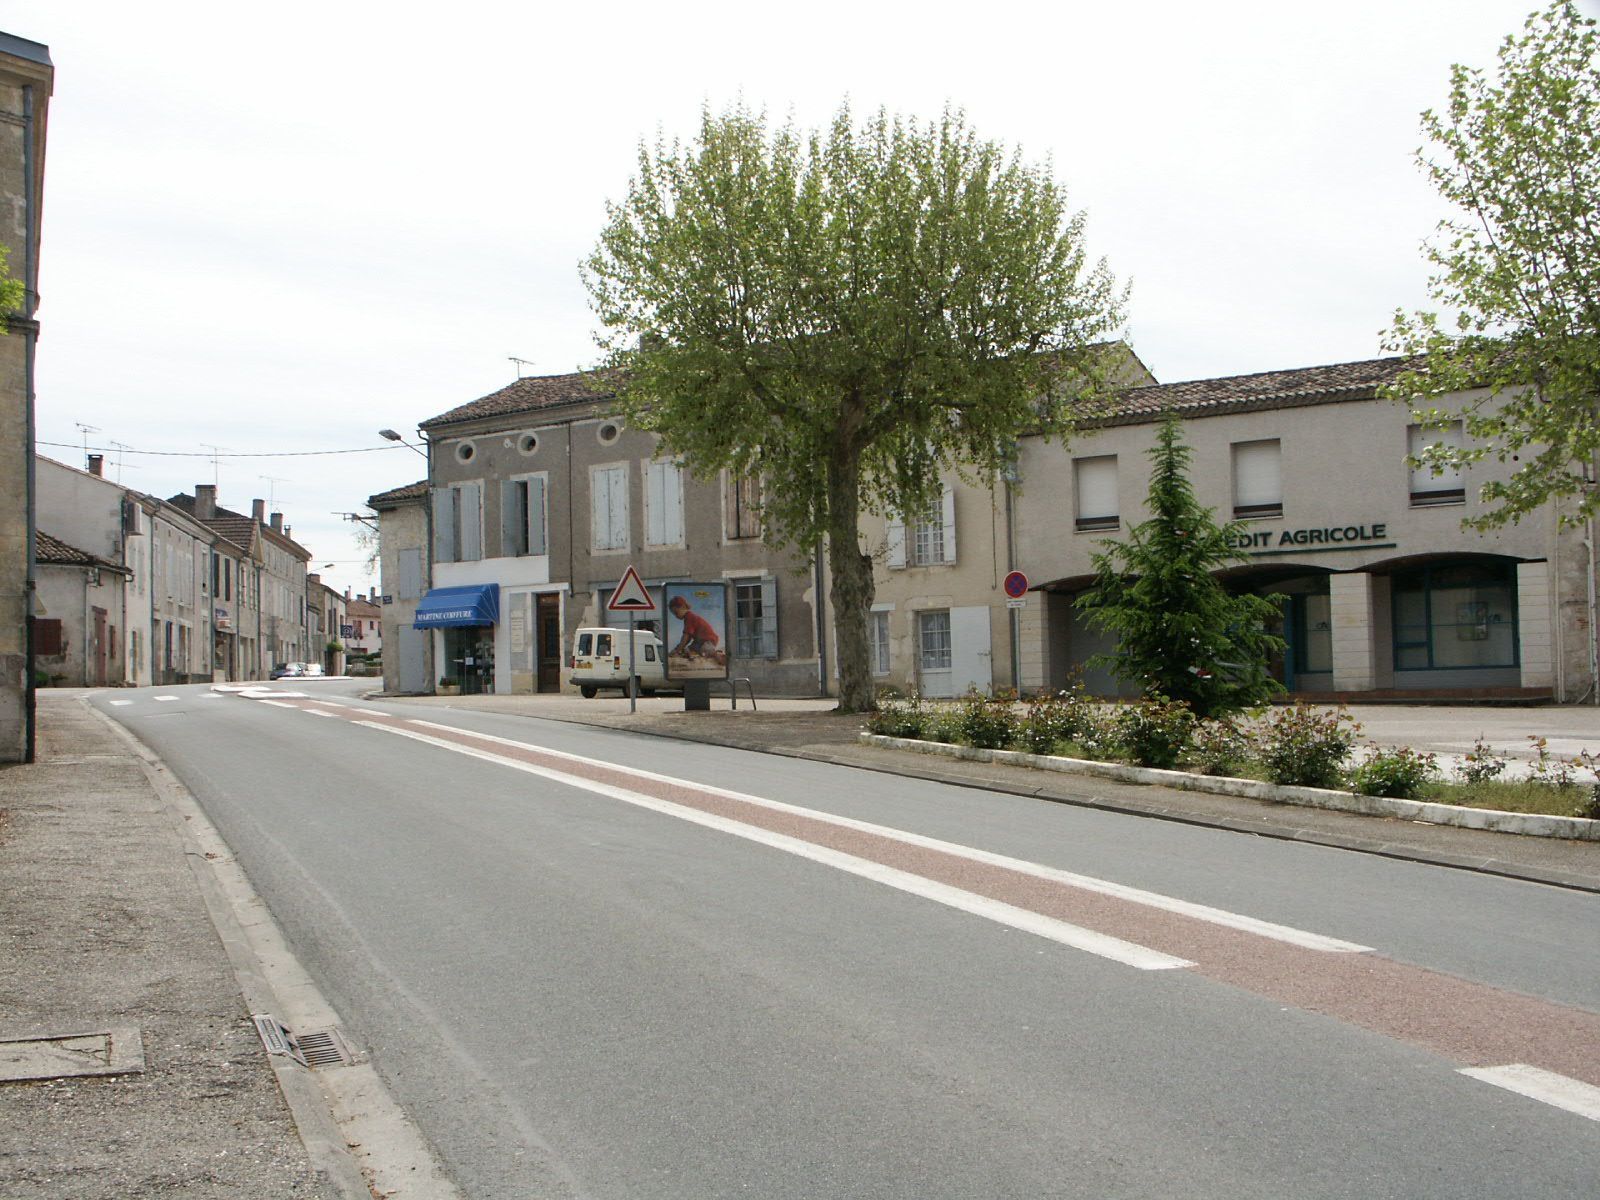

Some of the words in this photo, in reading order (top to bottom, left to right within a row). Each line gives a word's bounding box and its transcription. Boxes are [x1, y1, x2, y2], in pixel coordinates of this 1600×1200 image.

[1278, 523, 1386, 546] AGRICOLE
[417, 612, 442, 621] MARTINE
[443, 610, 472, 619] COIFFURE
